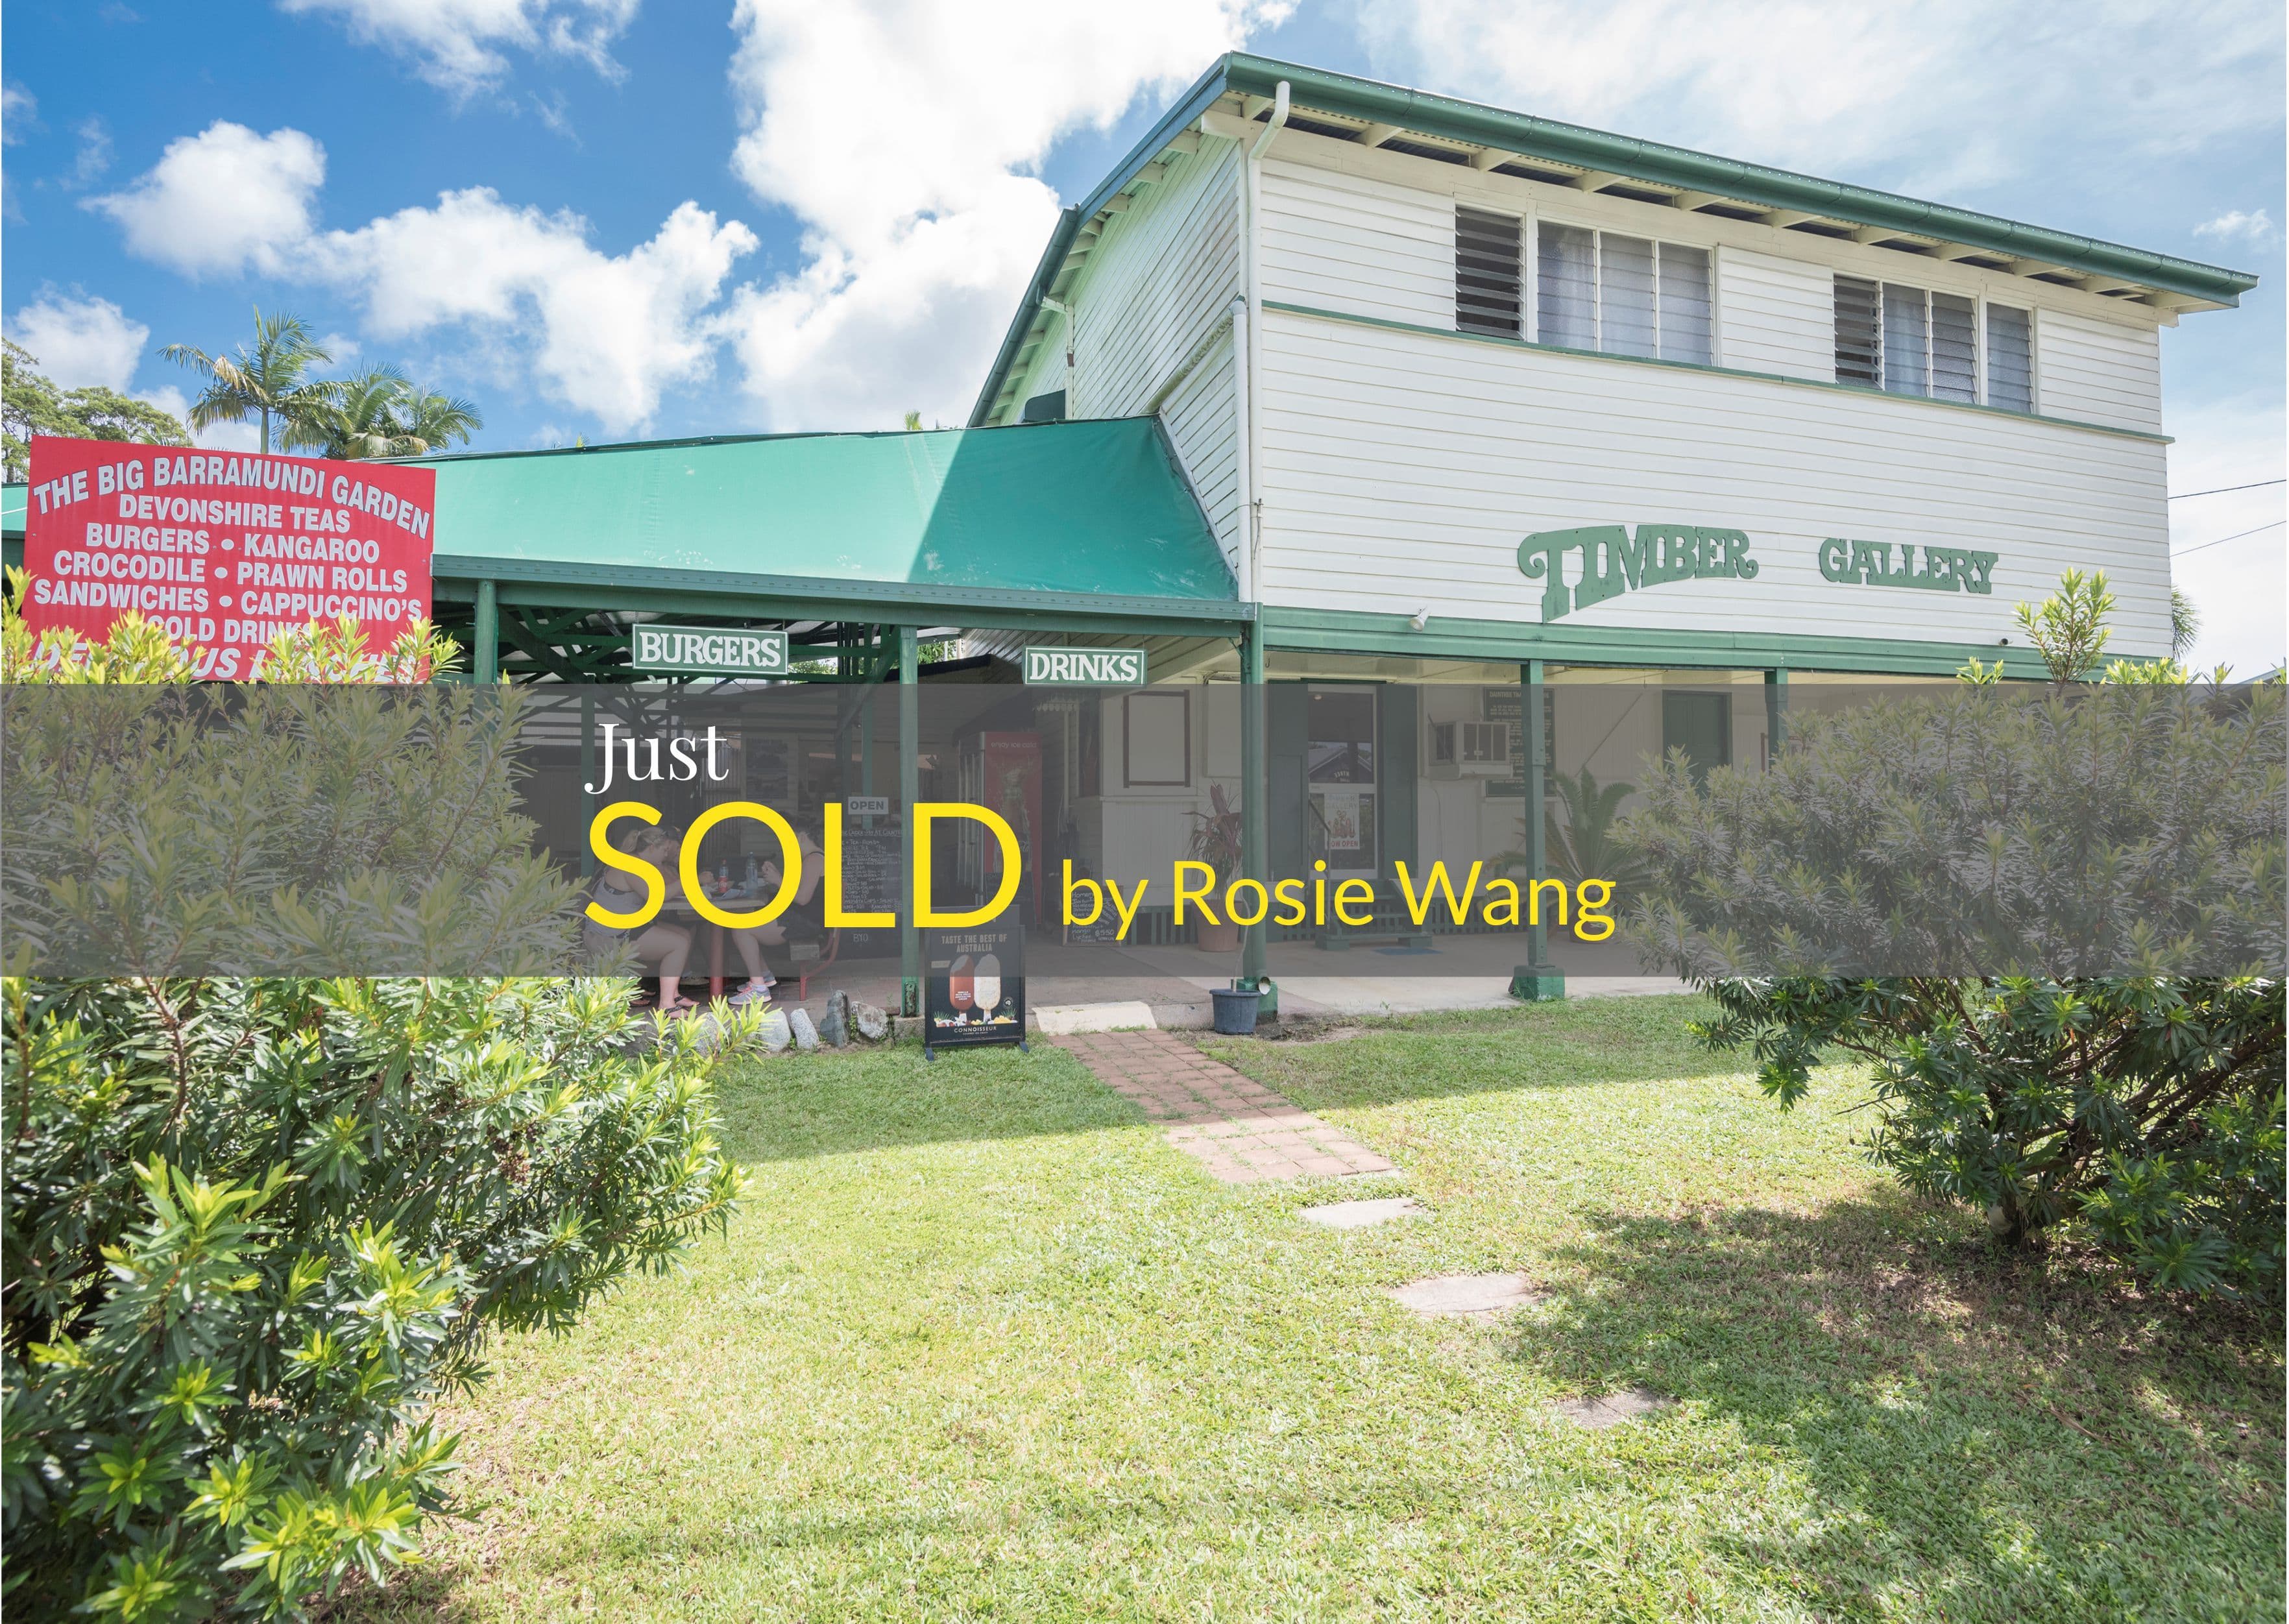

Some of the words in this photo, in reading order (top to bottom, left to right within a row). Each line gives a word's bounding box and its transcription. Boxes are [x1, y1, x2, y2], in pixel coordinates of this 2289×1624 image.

[33, 470, 89, 515] THE
[98, 459, 144, 496] BIG
[153, 455, 325, 498] BARRAMUNDI
[332, 475, 430, 539] GARDEN
[119, 494, 283, 528] DEVONSHIRE
[290, 506, 350, 533] TEAS
[86, 522, 210, 555] BURGERS
[244, 533, 380, 563] KANGAROO
[54, 550, 206, 583] CROCODILE
[237, 562, 324, 588] PRAWN
[332, 567, 407, 593] ROLLS
[1518, 524, 1759, 624] TIMBER
[1819, 538, 1998, 594] GALLERY
[34, 579, 209, 612] SANDWICHES
[241, 590, 422, 622] CAPPUCCINO'S
[639, 632, 781, 667] BURGERS
[1030, 653, 1137, 681] DRINKS
[850, 801, 884, 810] OPEN
[853, 934, 868, 943] BYO
[941, 935, 962, 944] TASTE
[964, 934, 977, 943] THE
[980, 934, 997, 943] BEST
[999, 934, 1008, 942] OF
[956, 943, 993, 952] AUSTRALIA
